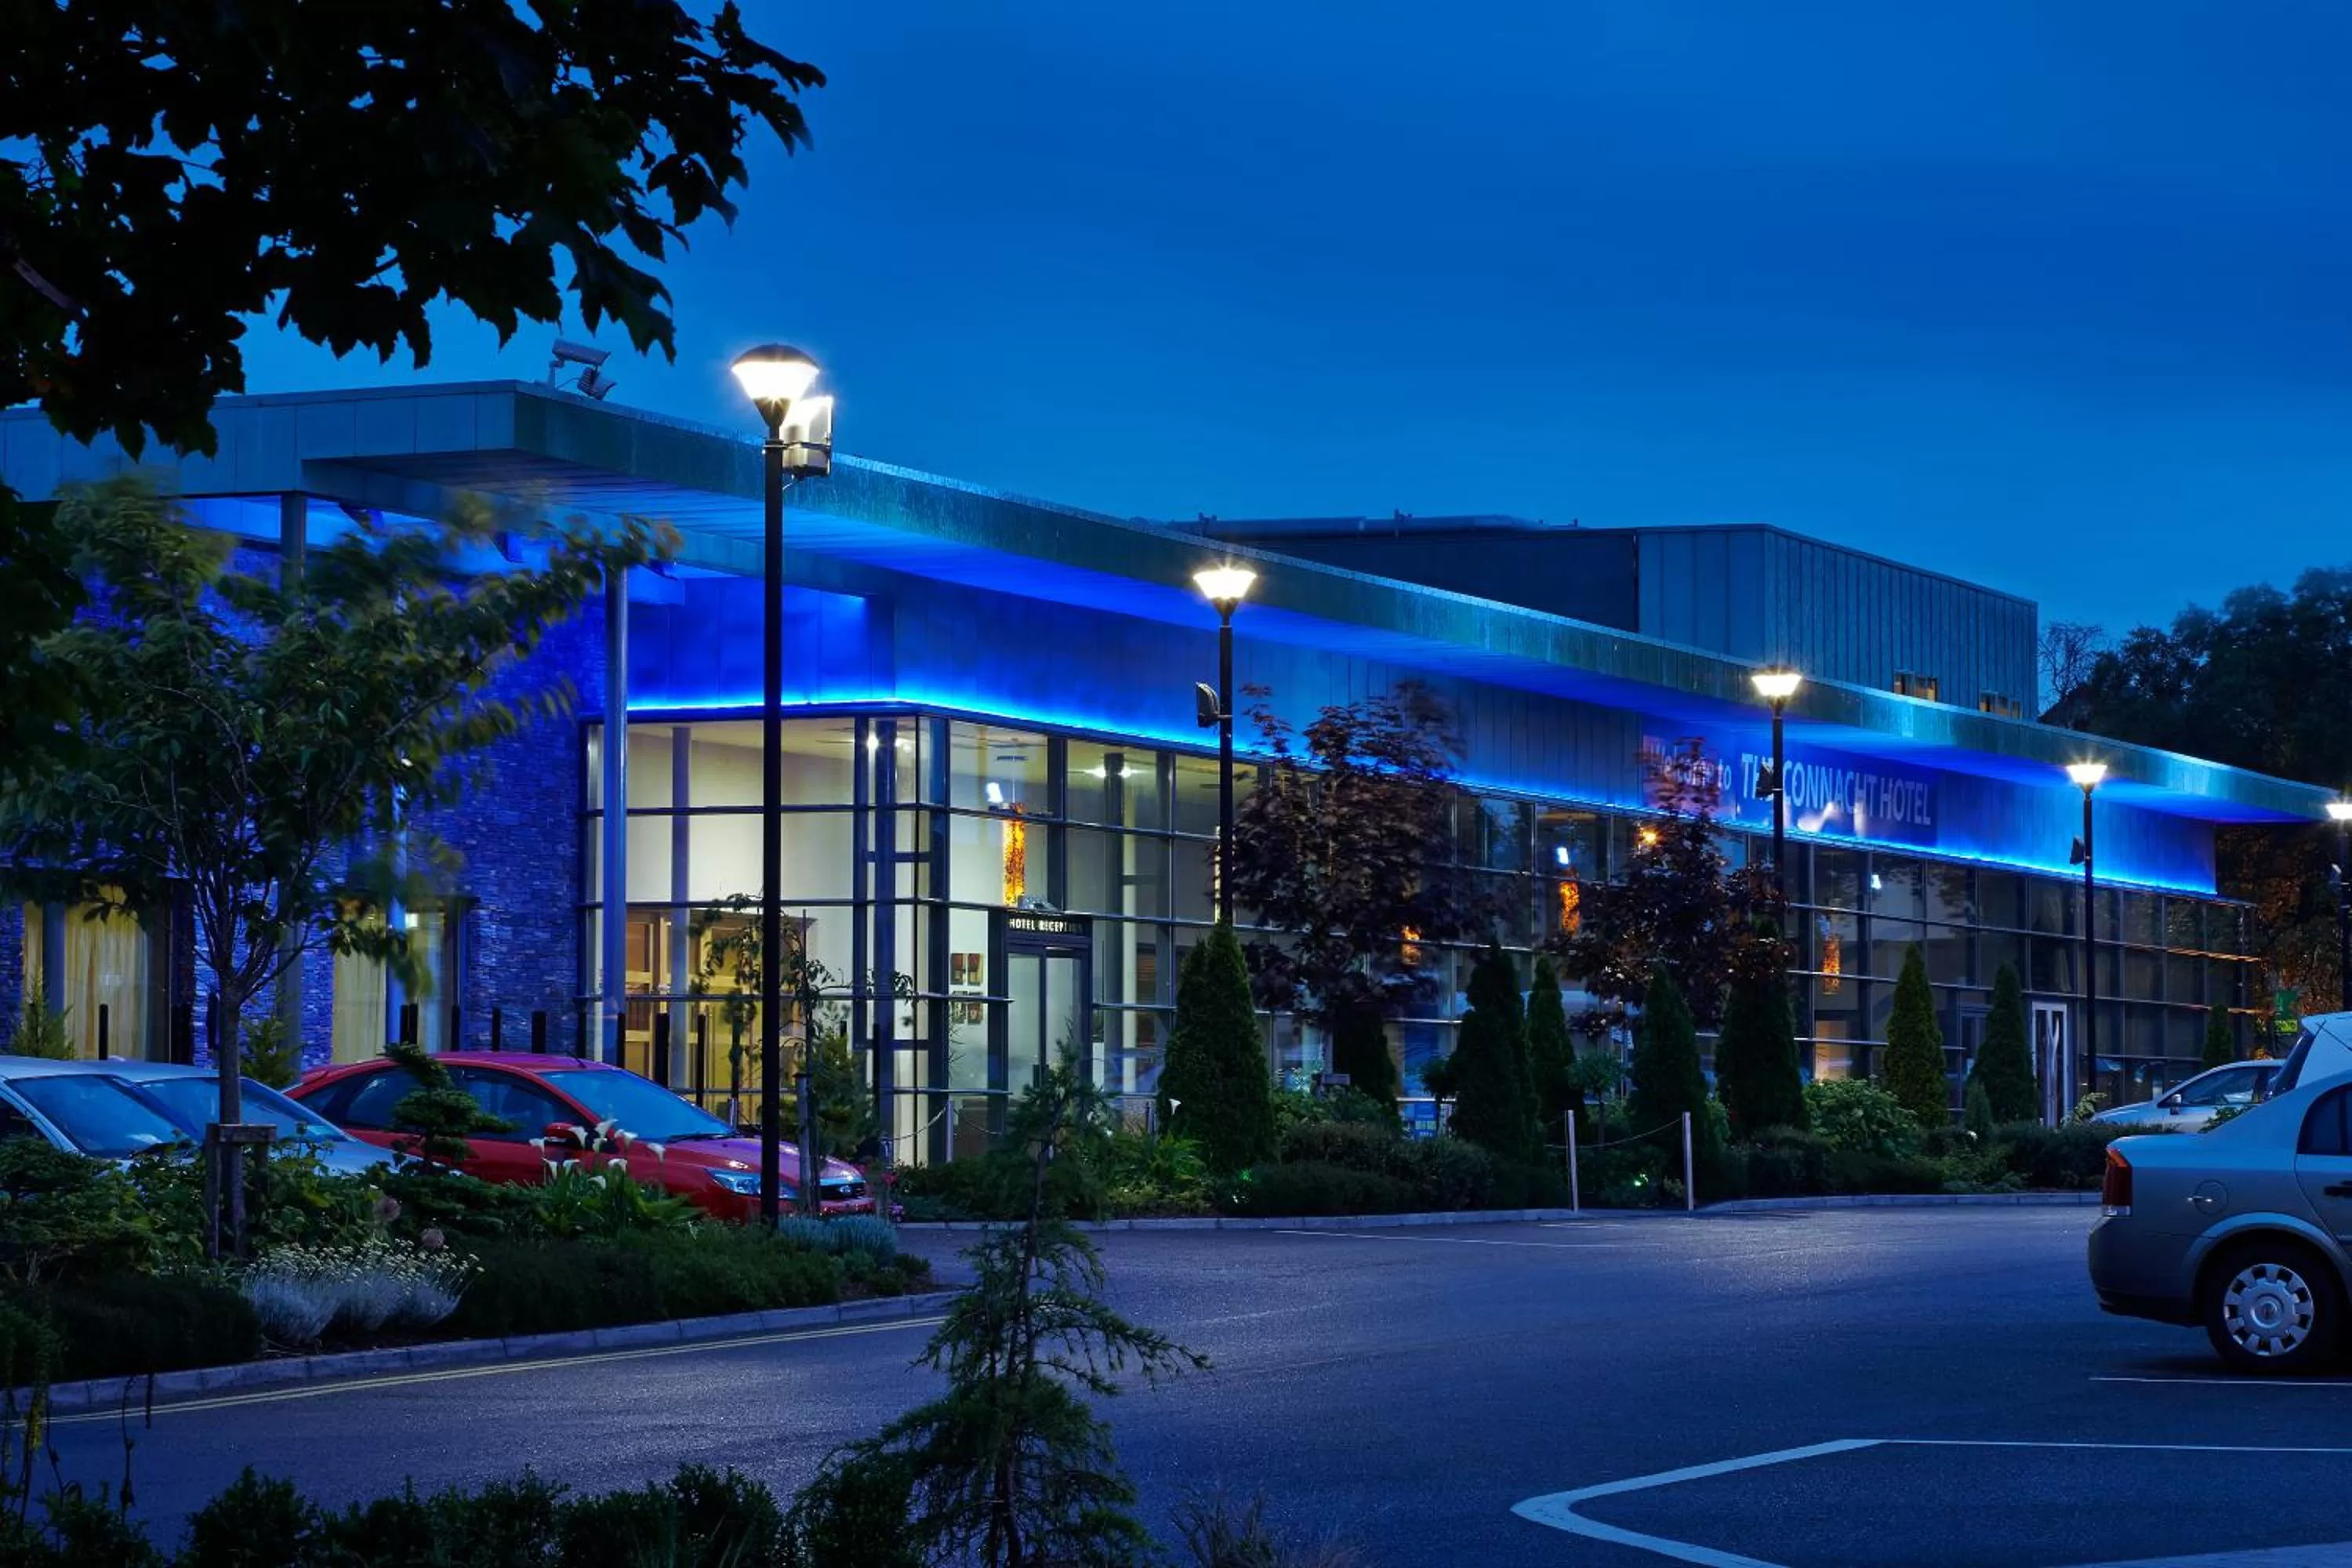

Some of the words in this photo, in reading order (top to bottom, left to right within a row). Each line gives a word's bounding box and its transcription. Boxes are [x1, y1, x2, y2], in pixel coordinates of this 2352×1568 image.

[1718, 758, 1732, 790] to
[1782, 760, 1878, 817] CONNACHT
[1879, 777, 1932, 826] HOTEL
[1009, 918, 1035, 931] HOTEL
